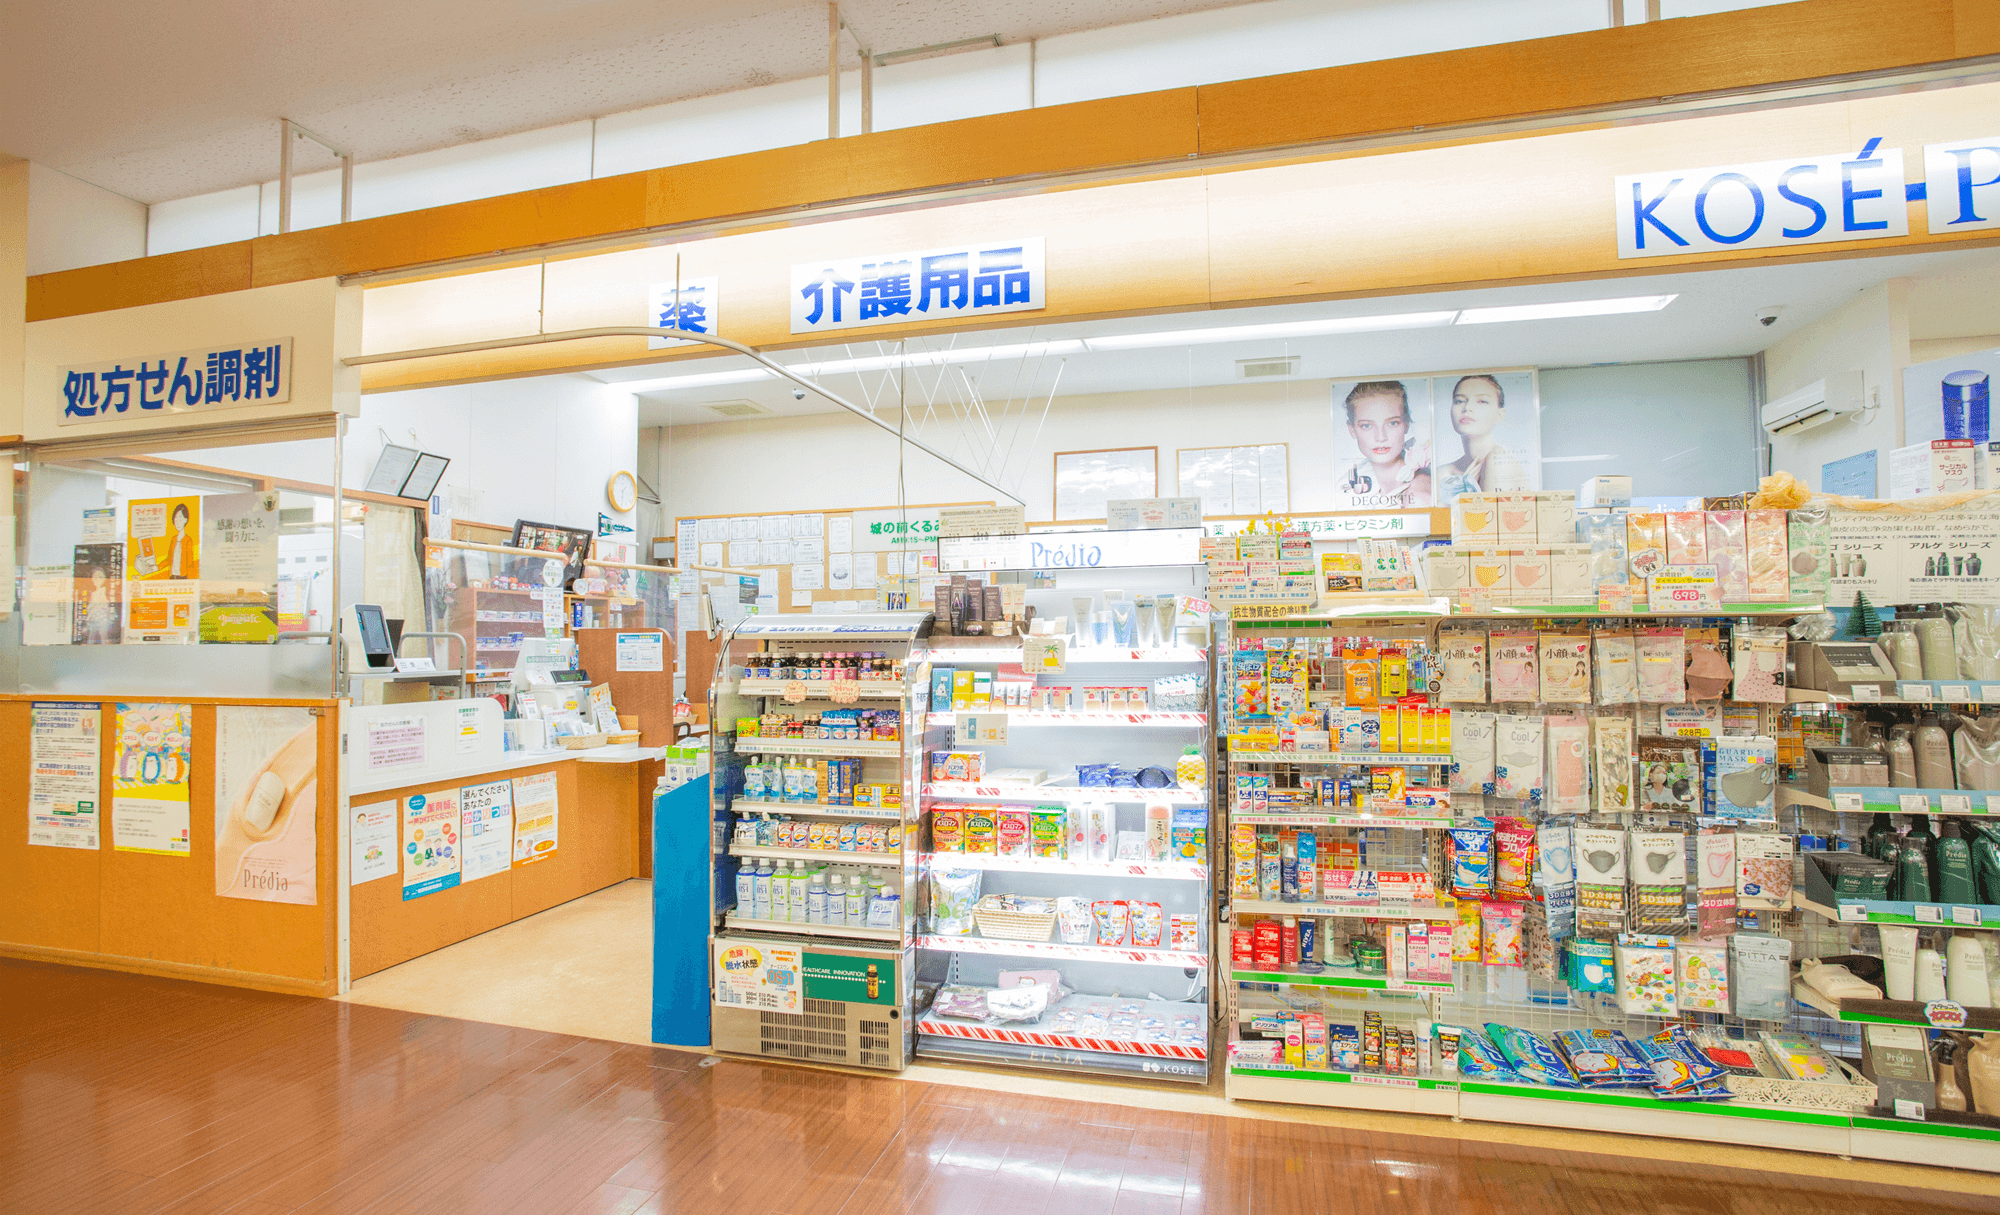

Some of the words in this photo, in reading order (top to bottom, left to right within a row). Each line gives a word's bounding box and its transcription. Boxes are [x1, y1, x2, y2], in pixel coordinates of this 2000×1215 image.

[1633, 137, 1888, 249] KOSÉ
[800, 246, 1030, 325] 介護用品
[659, 286, 708, 340] 薬
[63, 344, 281, 418] 処方せん調剤
[1352, 492, 1415, 507] DECORTÉ
[1674, 591, 1697, 600] 698
[1462, 726, 1482, 738] Cool
[1511, 731, 1530, 742] Cool
[1496, 832, 1526, 842] 快適ガード
[1503, 842, 1521, 854] プロ
[243, 868, 288, 892] Prédia
[1324, 874, 1348, 882] あせも
[1302, 928, 1312, 948] NIVEA
[1738, 952, 1776, 962] PITTA
[725, 958, 758, 970] 脱水状態
[1030, 1050, 1084, 1066] ELSIA
[1885, 1052, 1914, 1062] Prédia
[1164, 1062, 1194, 1075] KOSÉ
